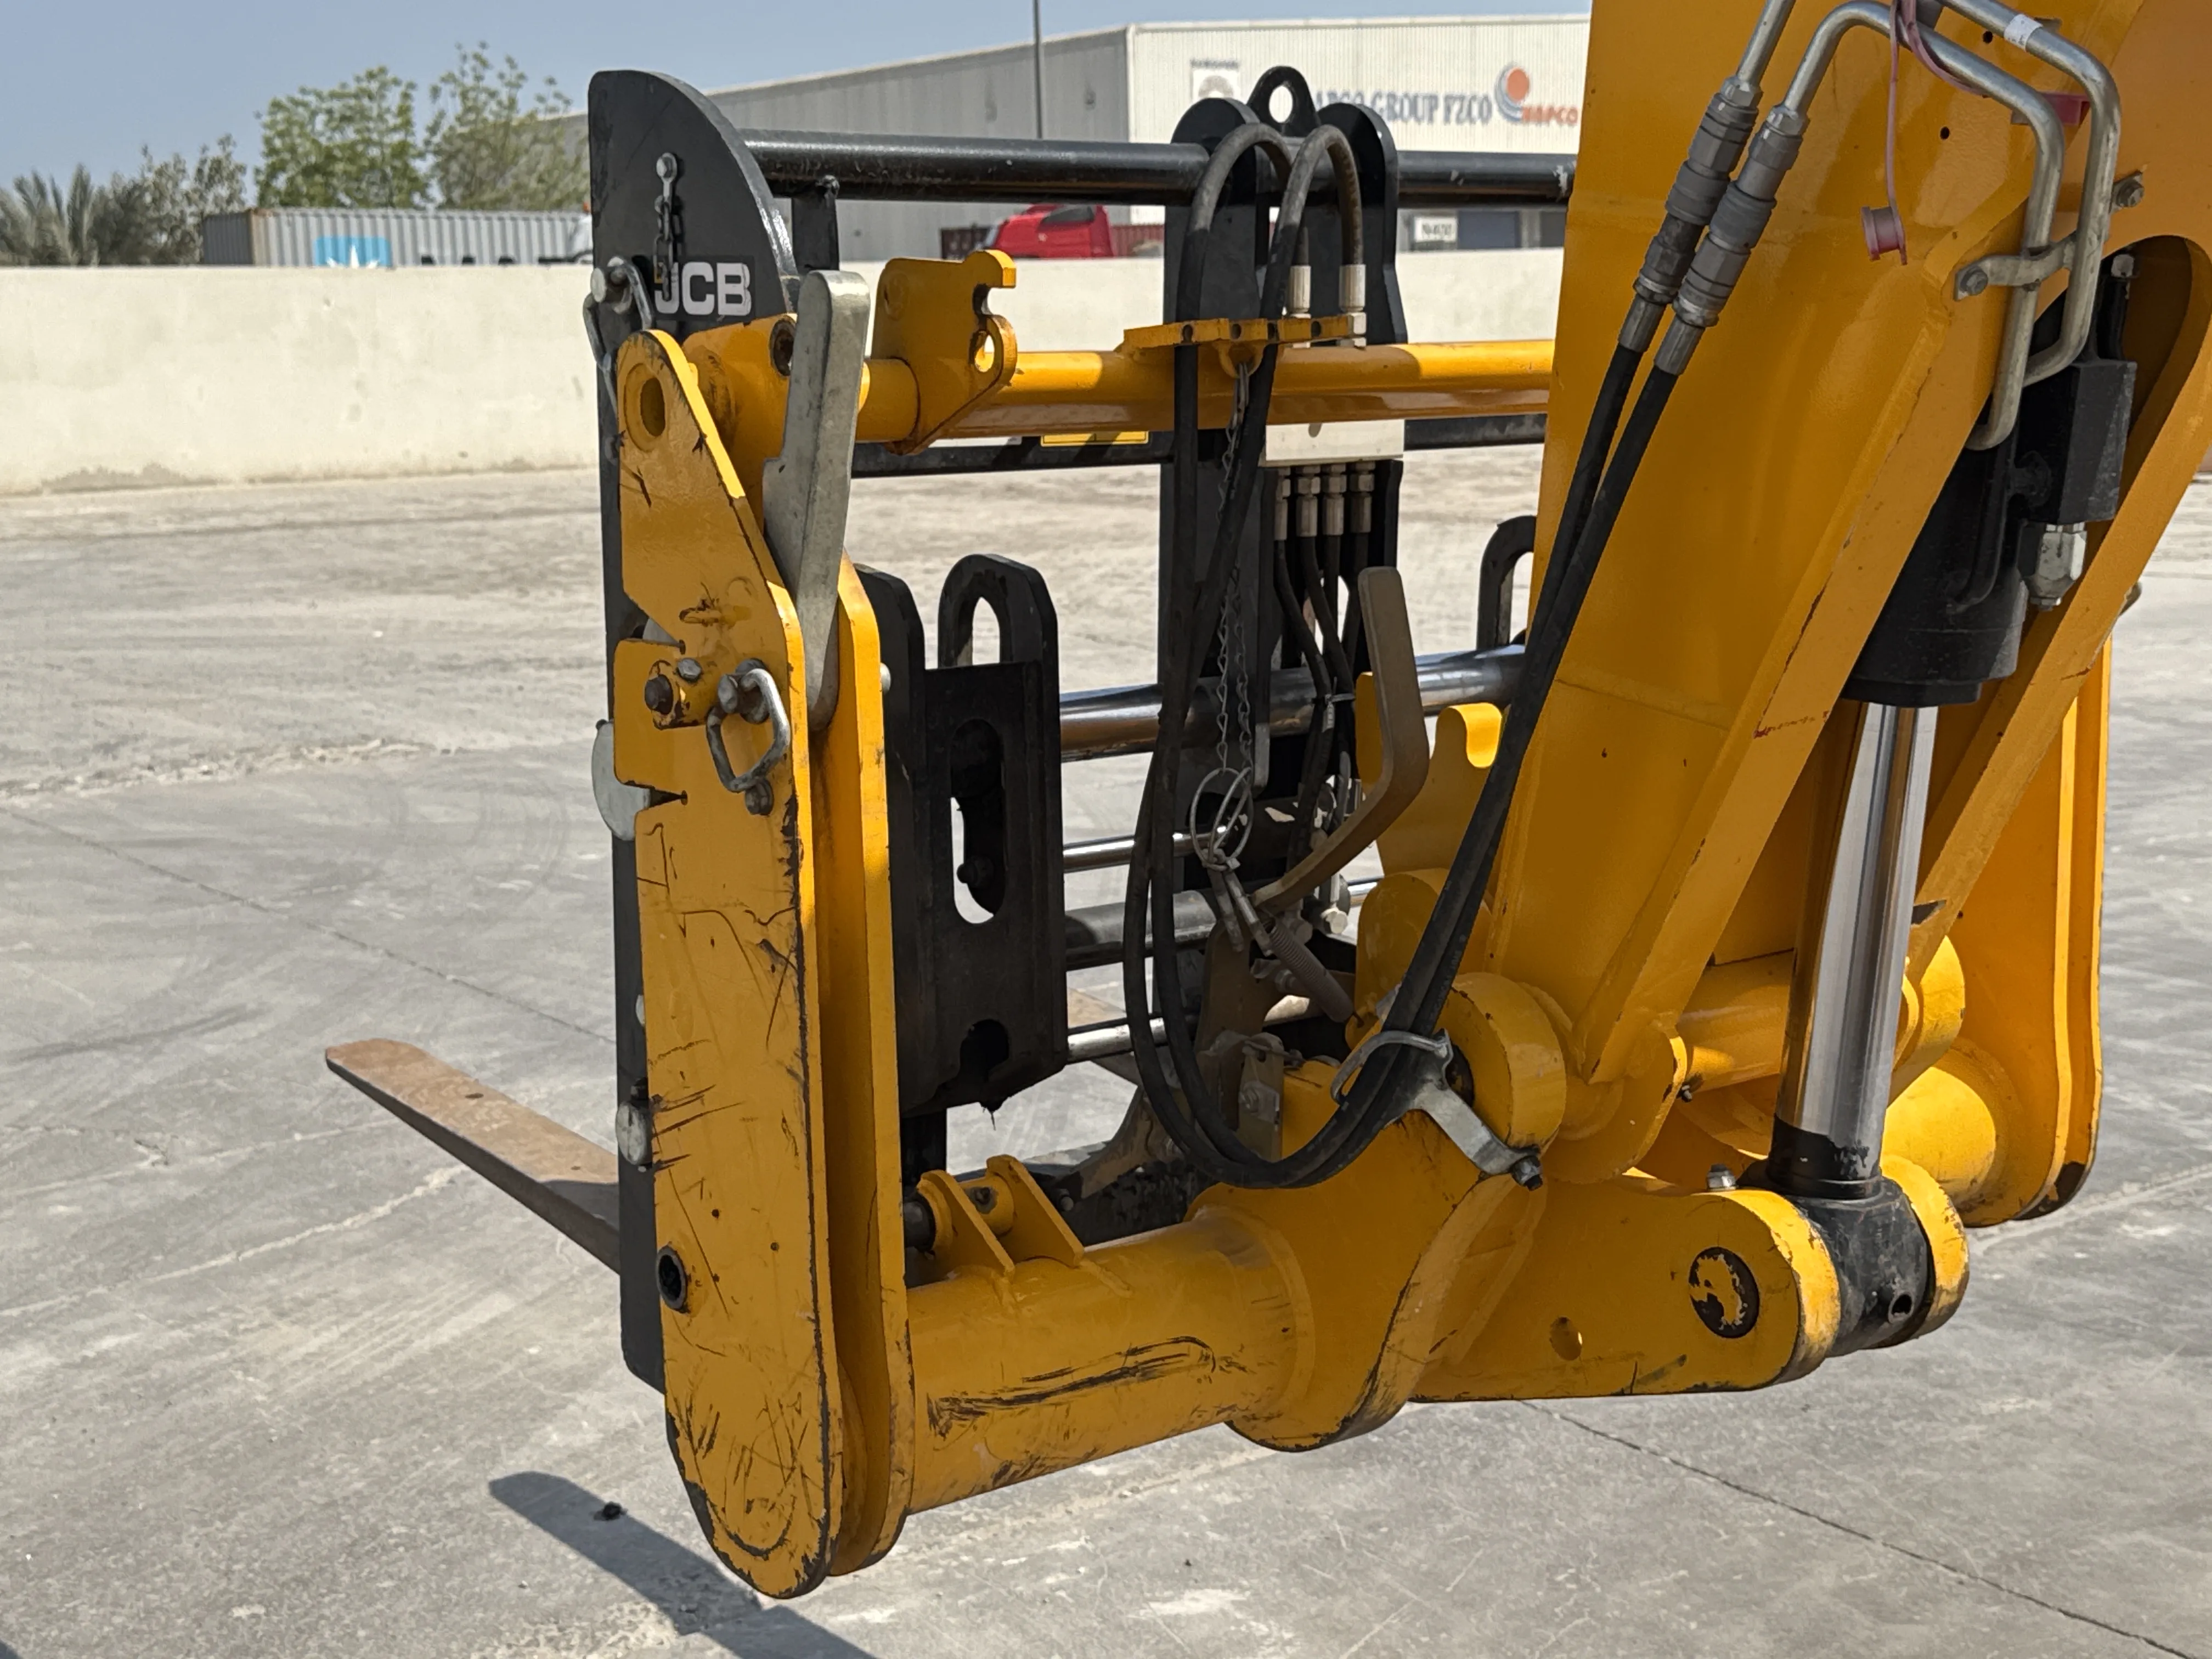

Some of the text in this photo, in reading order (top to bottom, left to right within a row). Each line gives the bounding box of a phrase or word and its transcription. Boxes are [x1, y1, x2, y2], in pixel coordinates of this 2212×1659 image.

[1370, 90, 1439, 125] GROUP
[1443, 92, 1493, 126] FZCO
[654, 262, 752, 315] JCB
